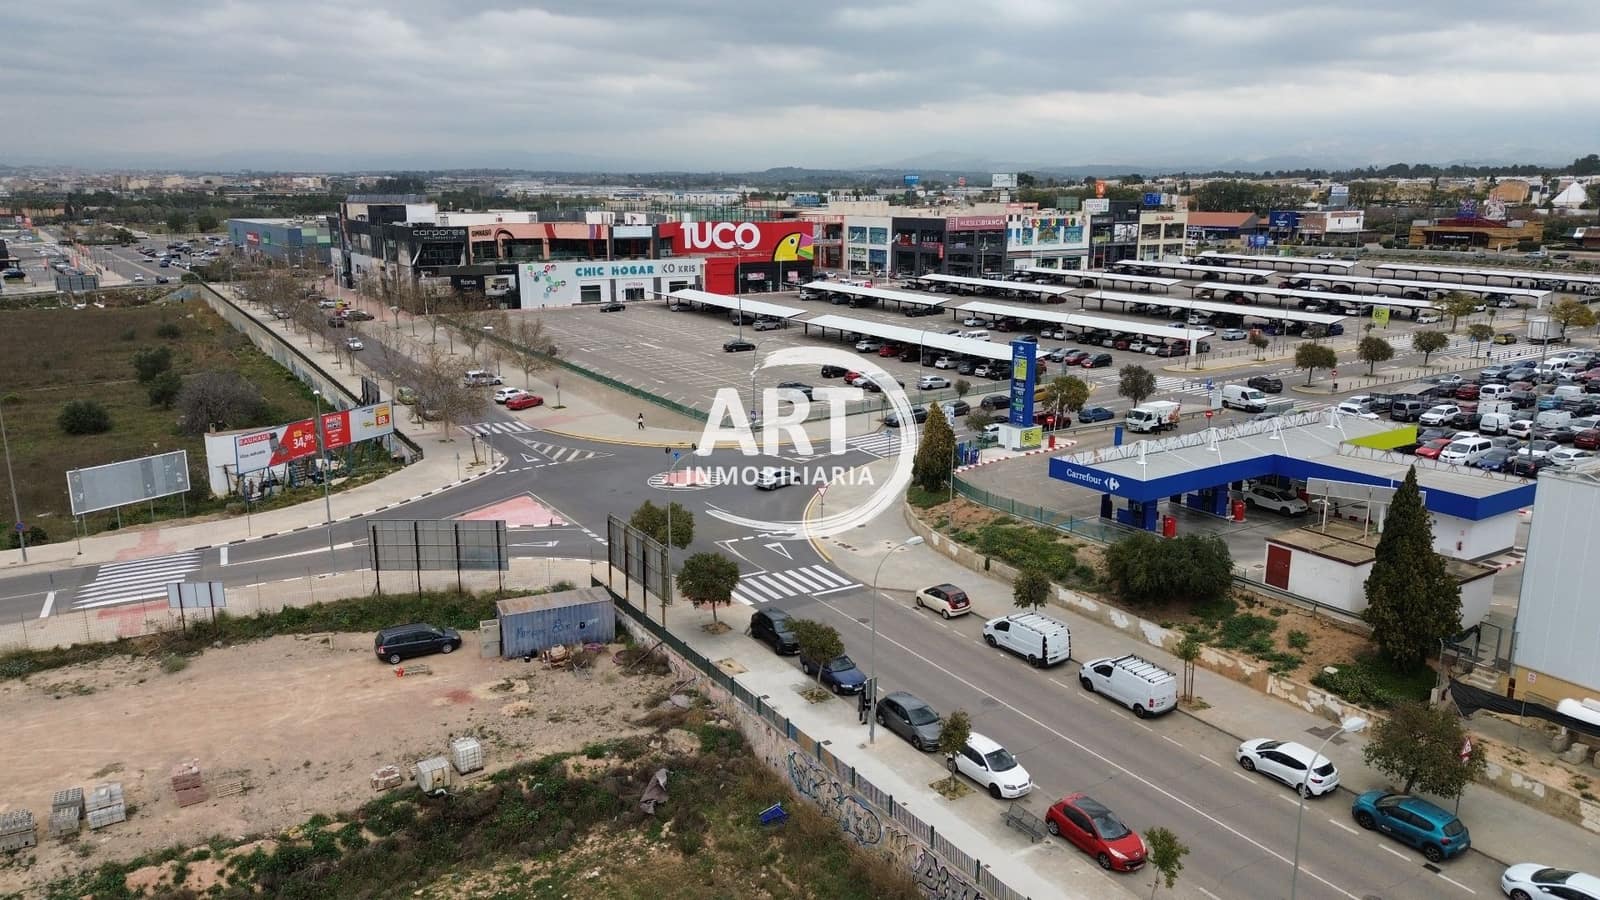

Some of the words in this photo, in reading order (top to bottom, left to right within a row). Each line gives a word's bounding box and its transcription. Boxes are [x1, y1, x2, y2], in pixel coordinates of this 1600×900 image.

[680, 222, 761, 249] TUCO
[575, 266, 604, 277] CHIC
[611, 265, 655, 276] HOGAR
[1066, 468, 1103, 486] Carrefour
